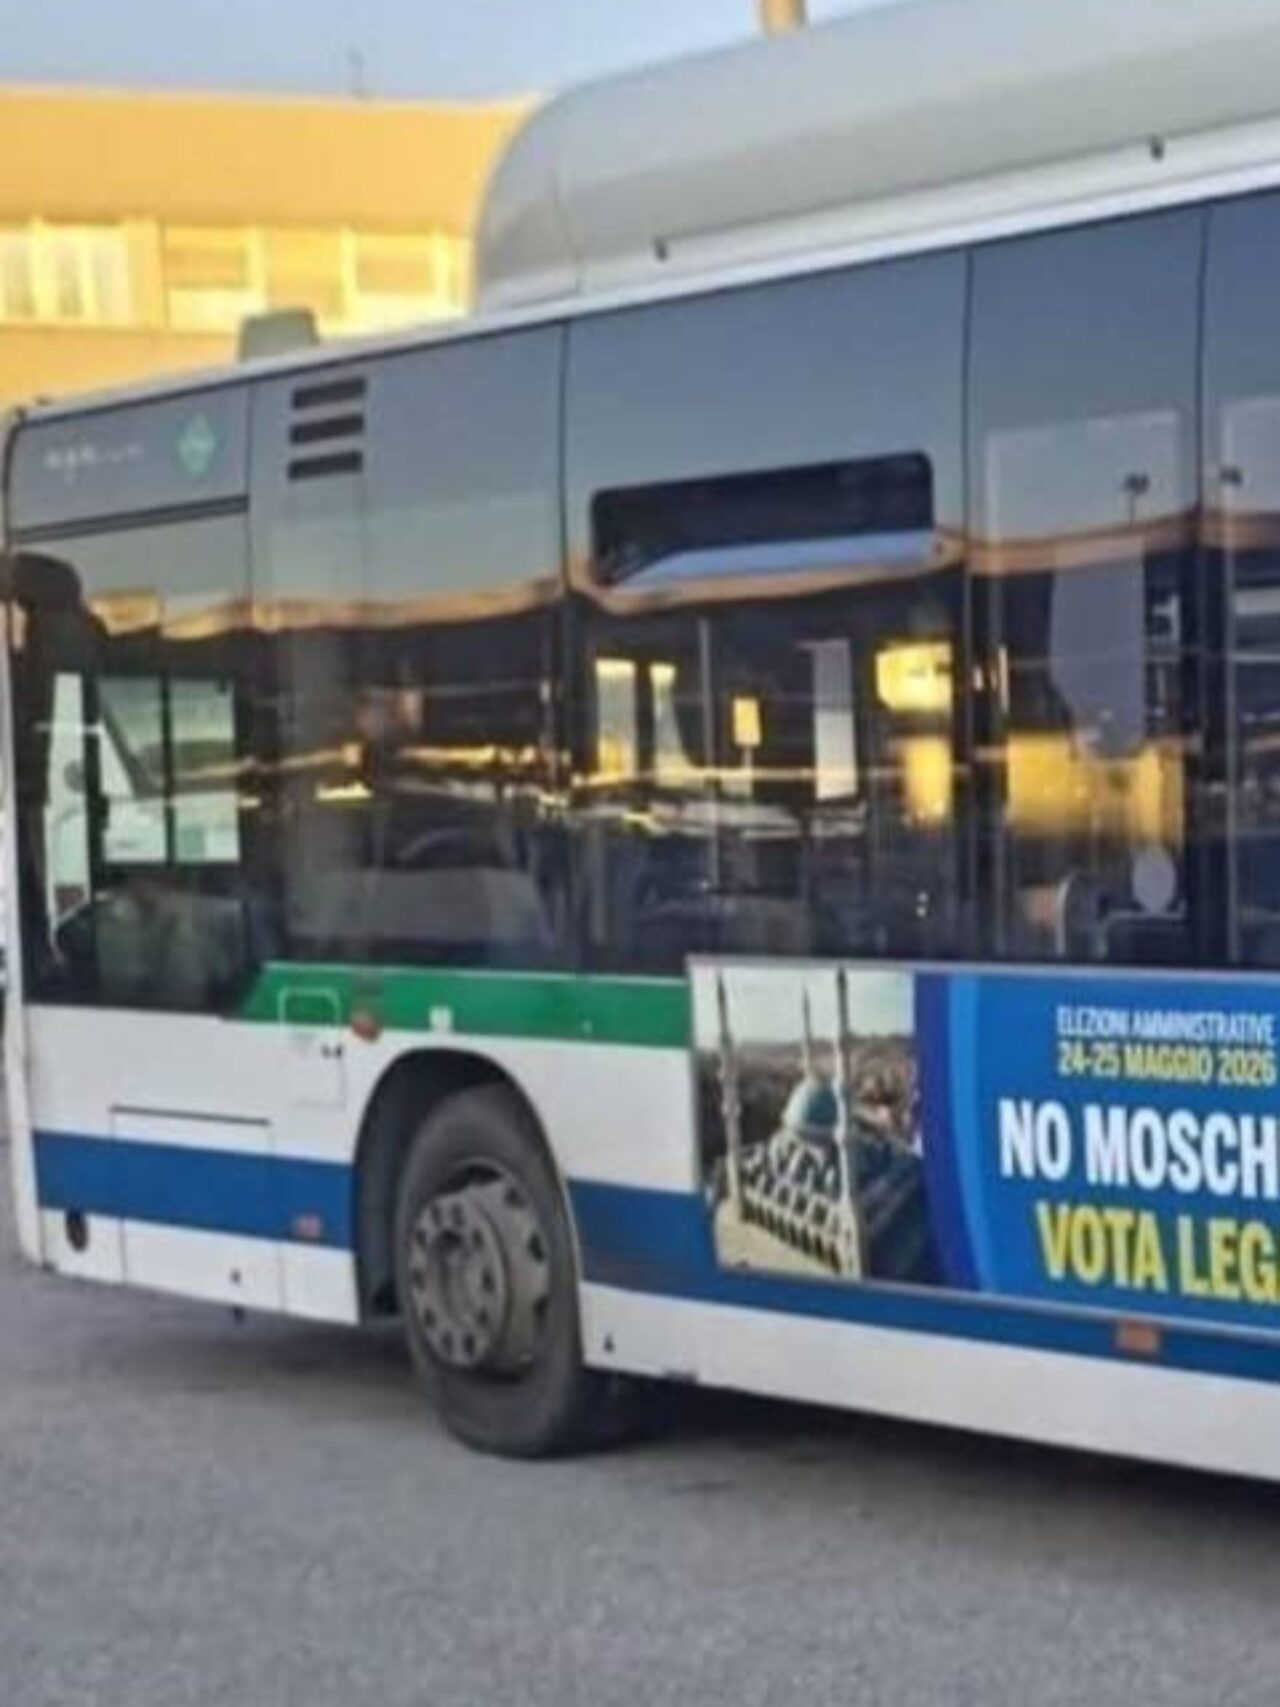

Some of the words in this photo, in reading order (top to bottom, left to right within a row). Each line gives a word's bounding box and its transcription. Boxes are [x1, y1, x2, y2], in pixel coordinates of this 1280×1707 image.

[1057, 1006, 1128, 1036] ELEZIONI
[1131, 1009, 1276, 1045] AMMINISTRATIVE
[1058, 1040, 1120, 1077] 24-25
[1123, 1043, 1213, 1083] MAGGIO
[1216, 1050, 1277, 1086] 2026
[998, 1098, 1072, 1181] NO
[1036, 1202, 1168, 1293] VOTA
